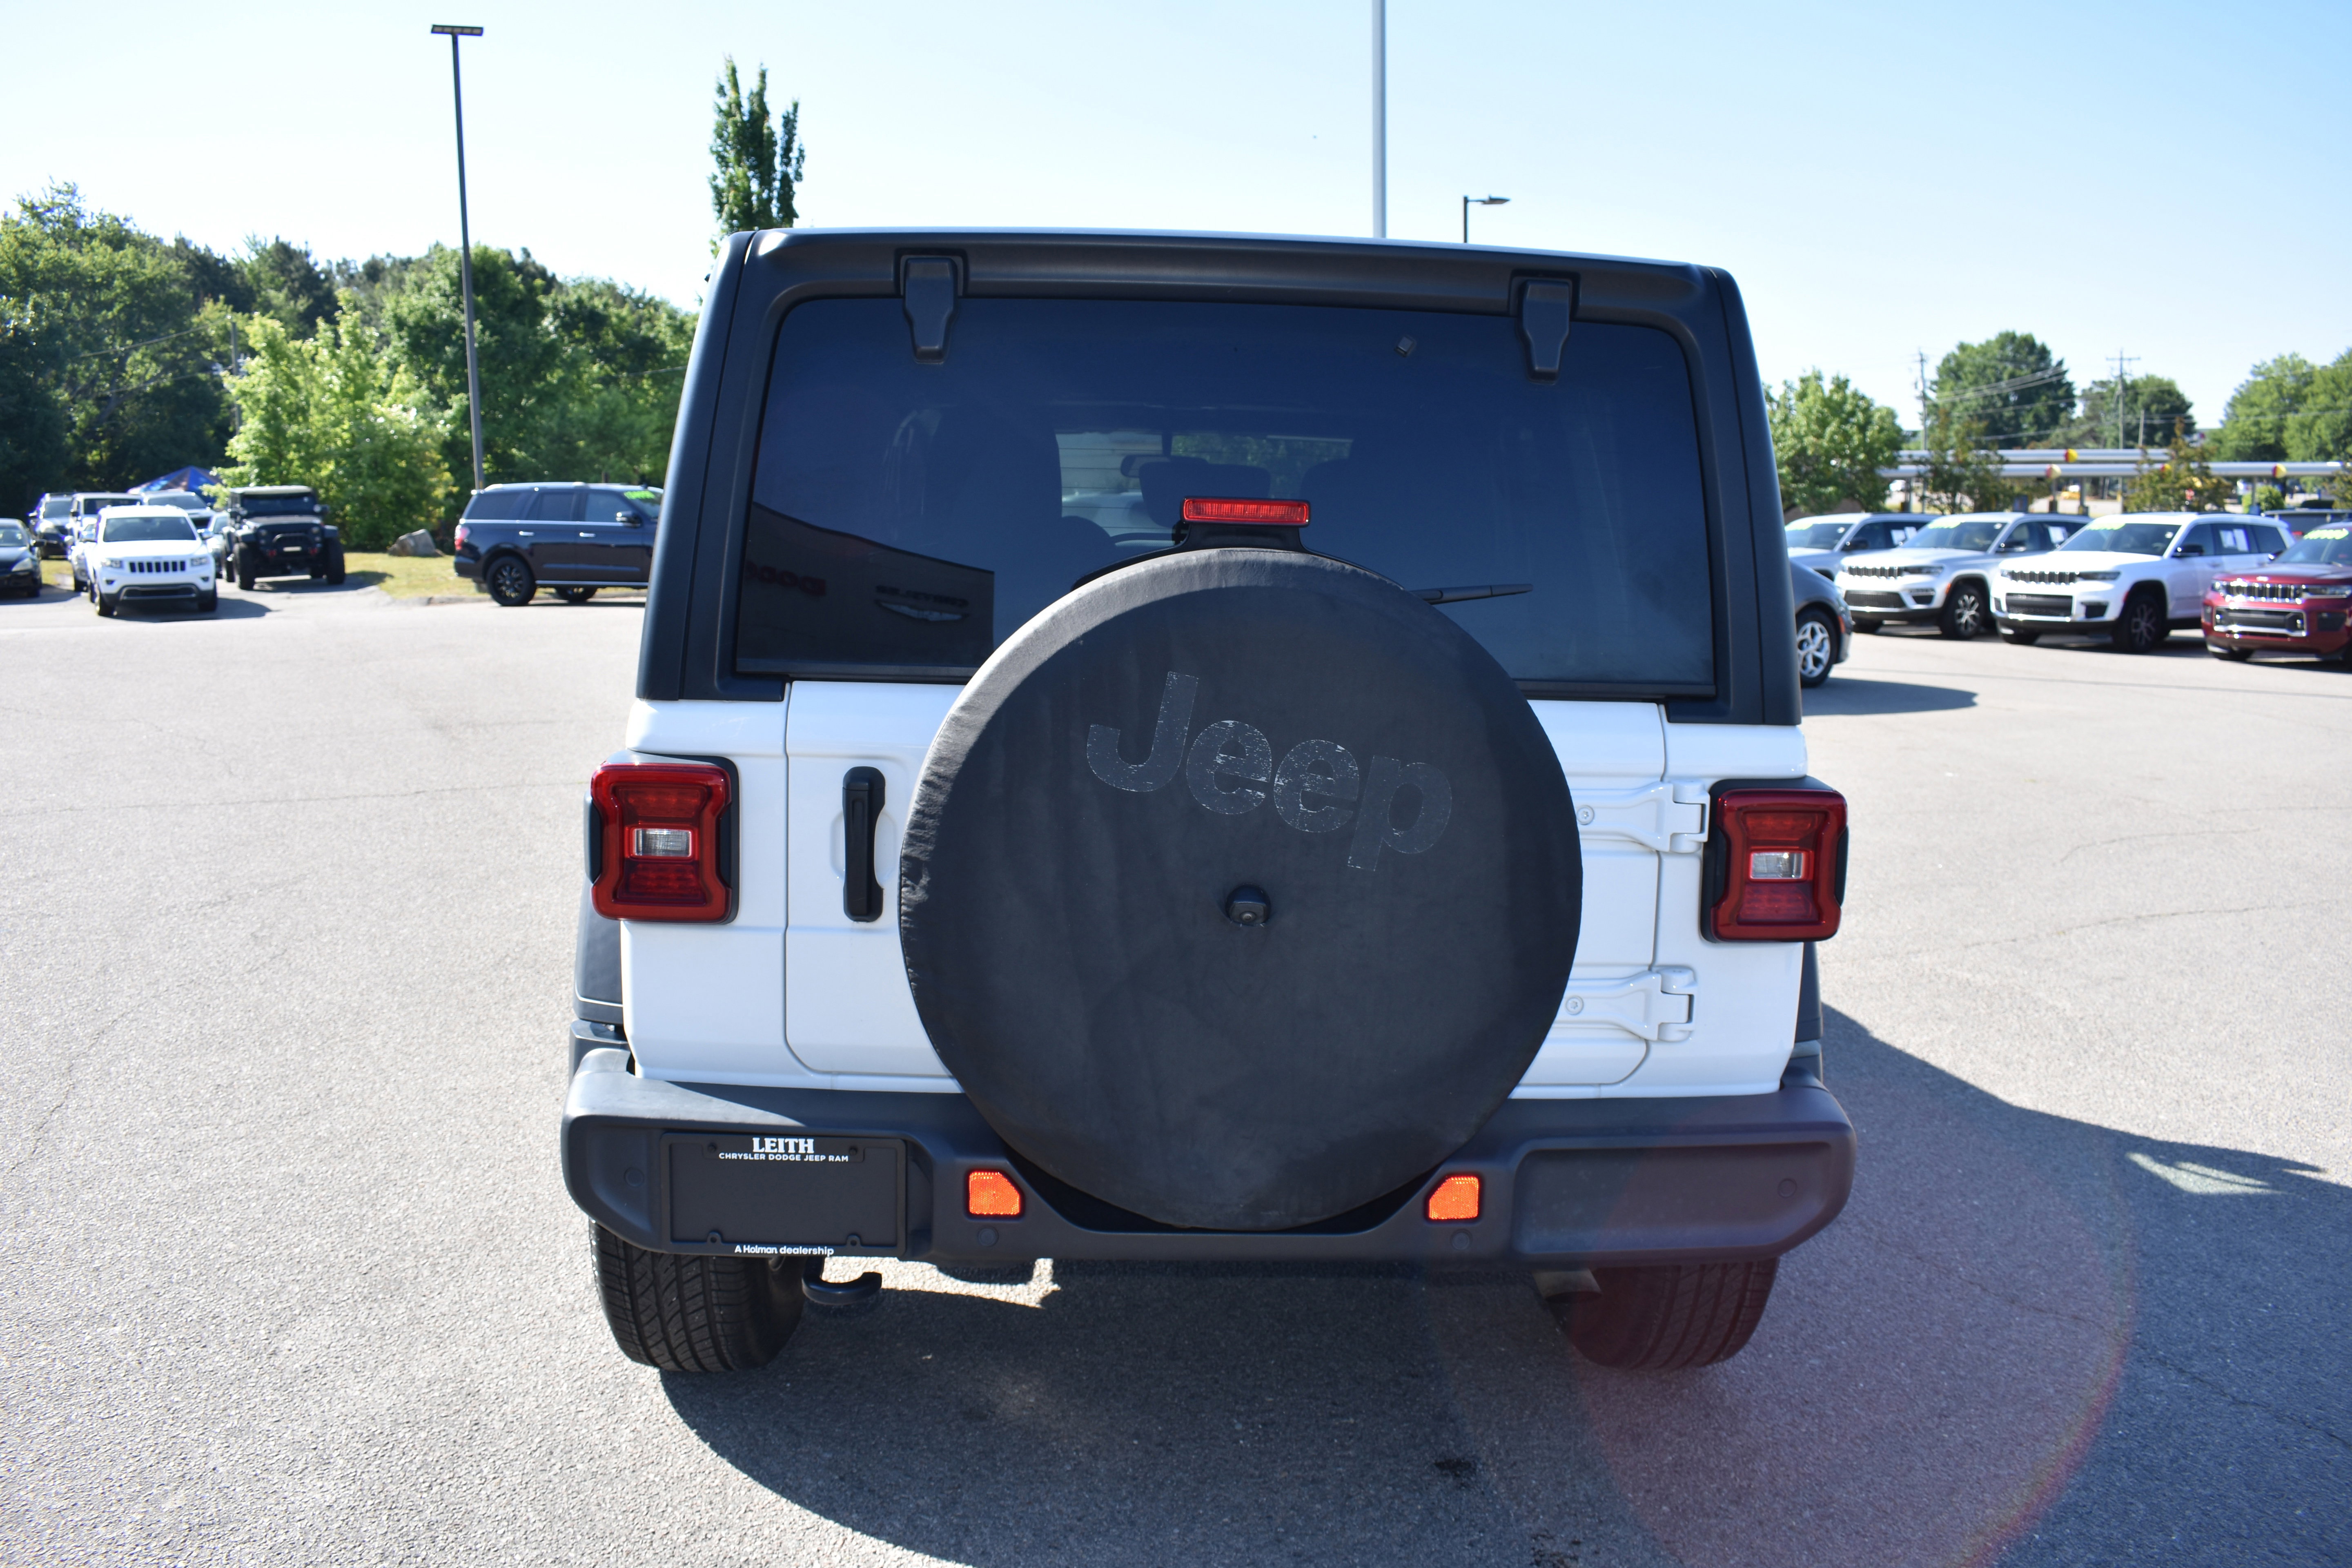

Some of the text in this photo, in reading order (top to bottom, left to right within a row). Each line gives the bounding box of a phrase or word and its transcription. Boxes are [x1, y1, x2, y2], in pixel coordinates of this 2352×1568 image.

[1087, 671, 1452, 871] Jeep
[753, 1137, 814, 1154] LEITH
[719, 1152, 766, 1160] CHRYSLER
[735, 1245, 834, 1256] A Holman dealership
